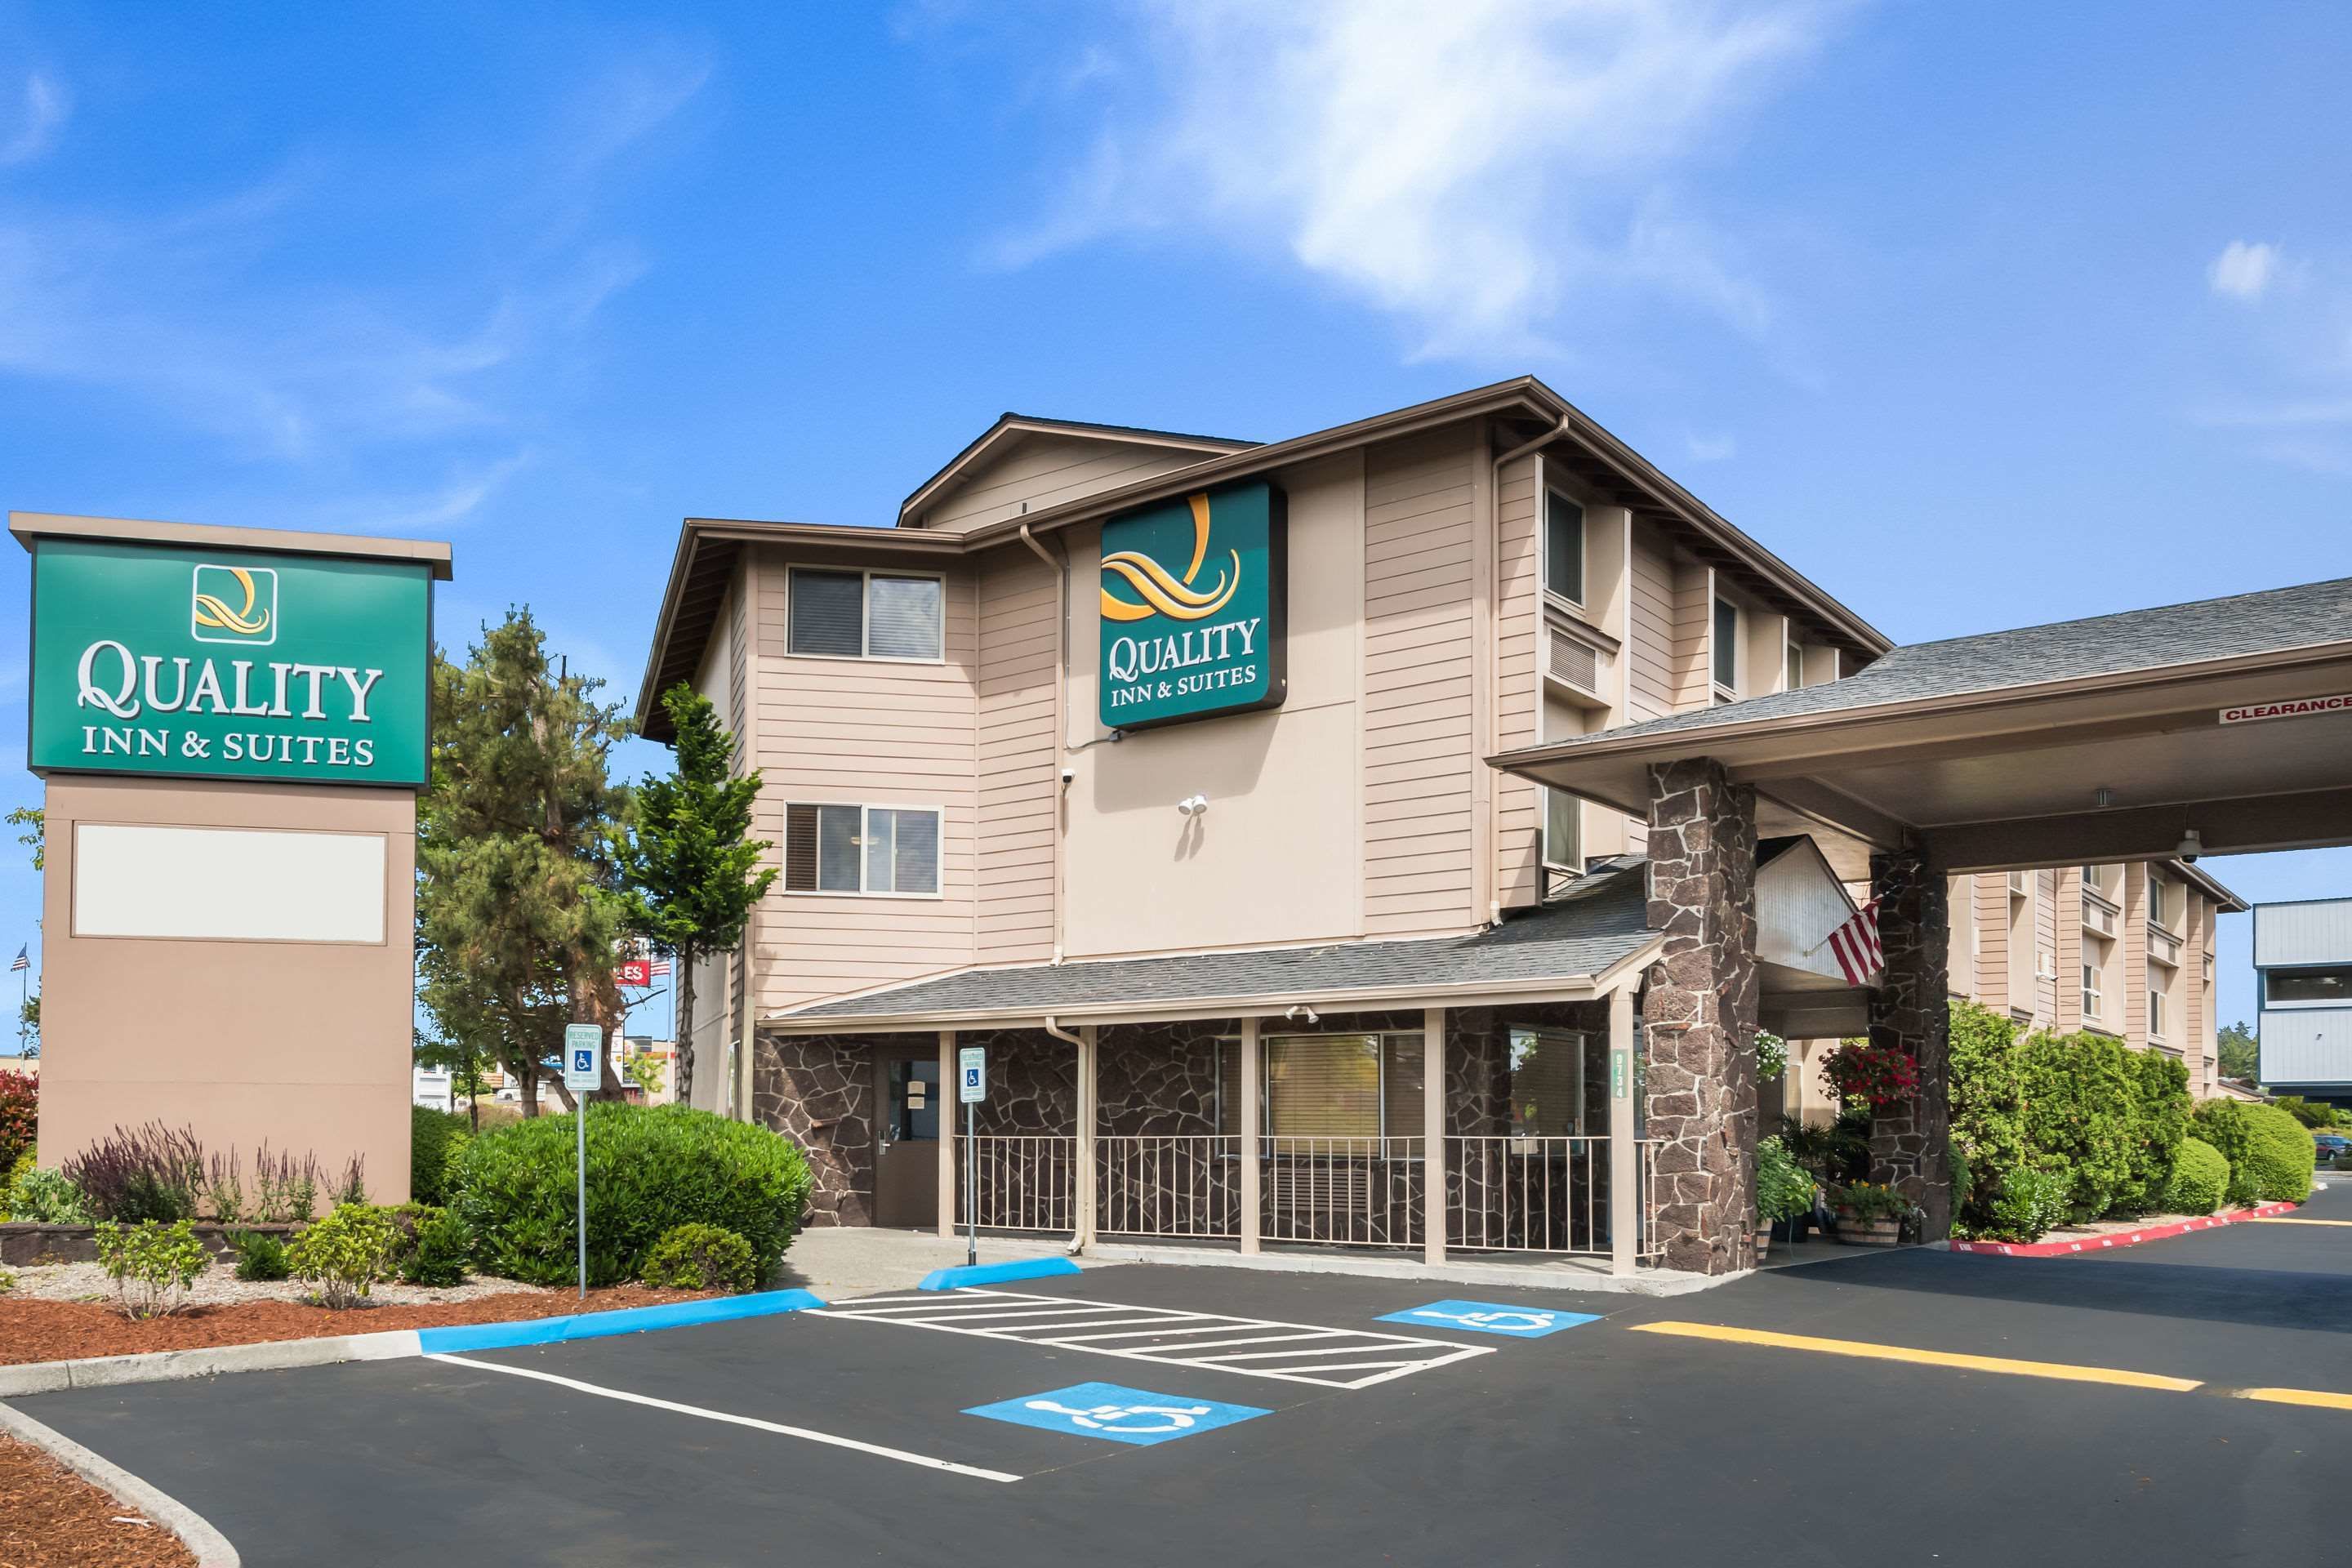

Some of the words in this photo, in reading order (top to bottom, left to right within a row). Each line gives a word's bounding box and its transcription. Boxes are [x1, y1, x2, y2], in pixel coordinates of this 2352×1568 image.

[1109, 617, 1260, 683] QUALITY
[77, 639, 383, 721] QUALITY
[1111, 684, 1152, 707] INN
[1157, 681, 1172, 699] &
[1177, 665, 1257, 696] SUITES
[2225, 697, 2352, 720] CLEARANCE
[82, 726, 170, 756] INN
[181, 730, 211, 758] &
[223, 733, 375, 766] SUITES
[569, 1031, 599, 1040] RESERVED
